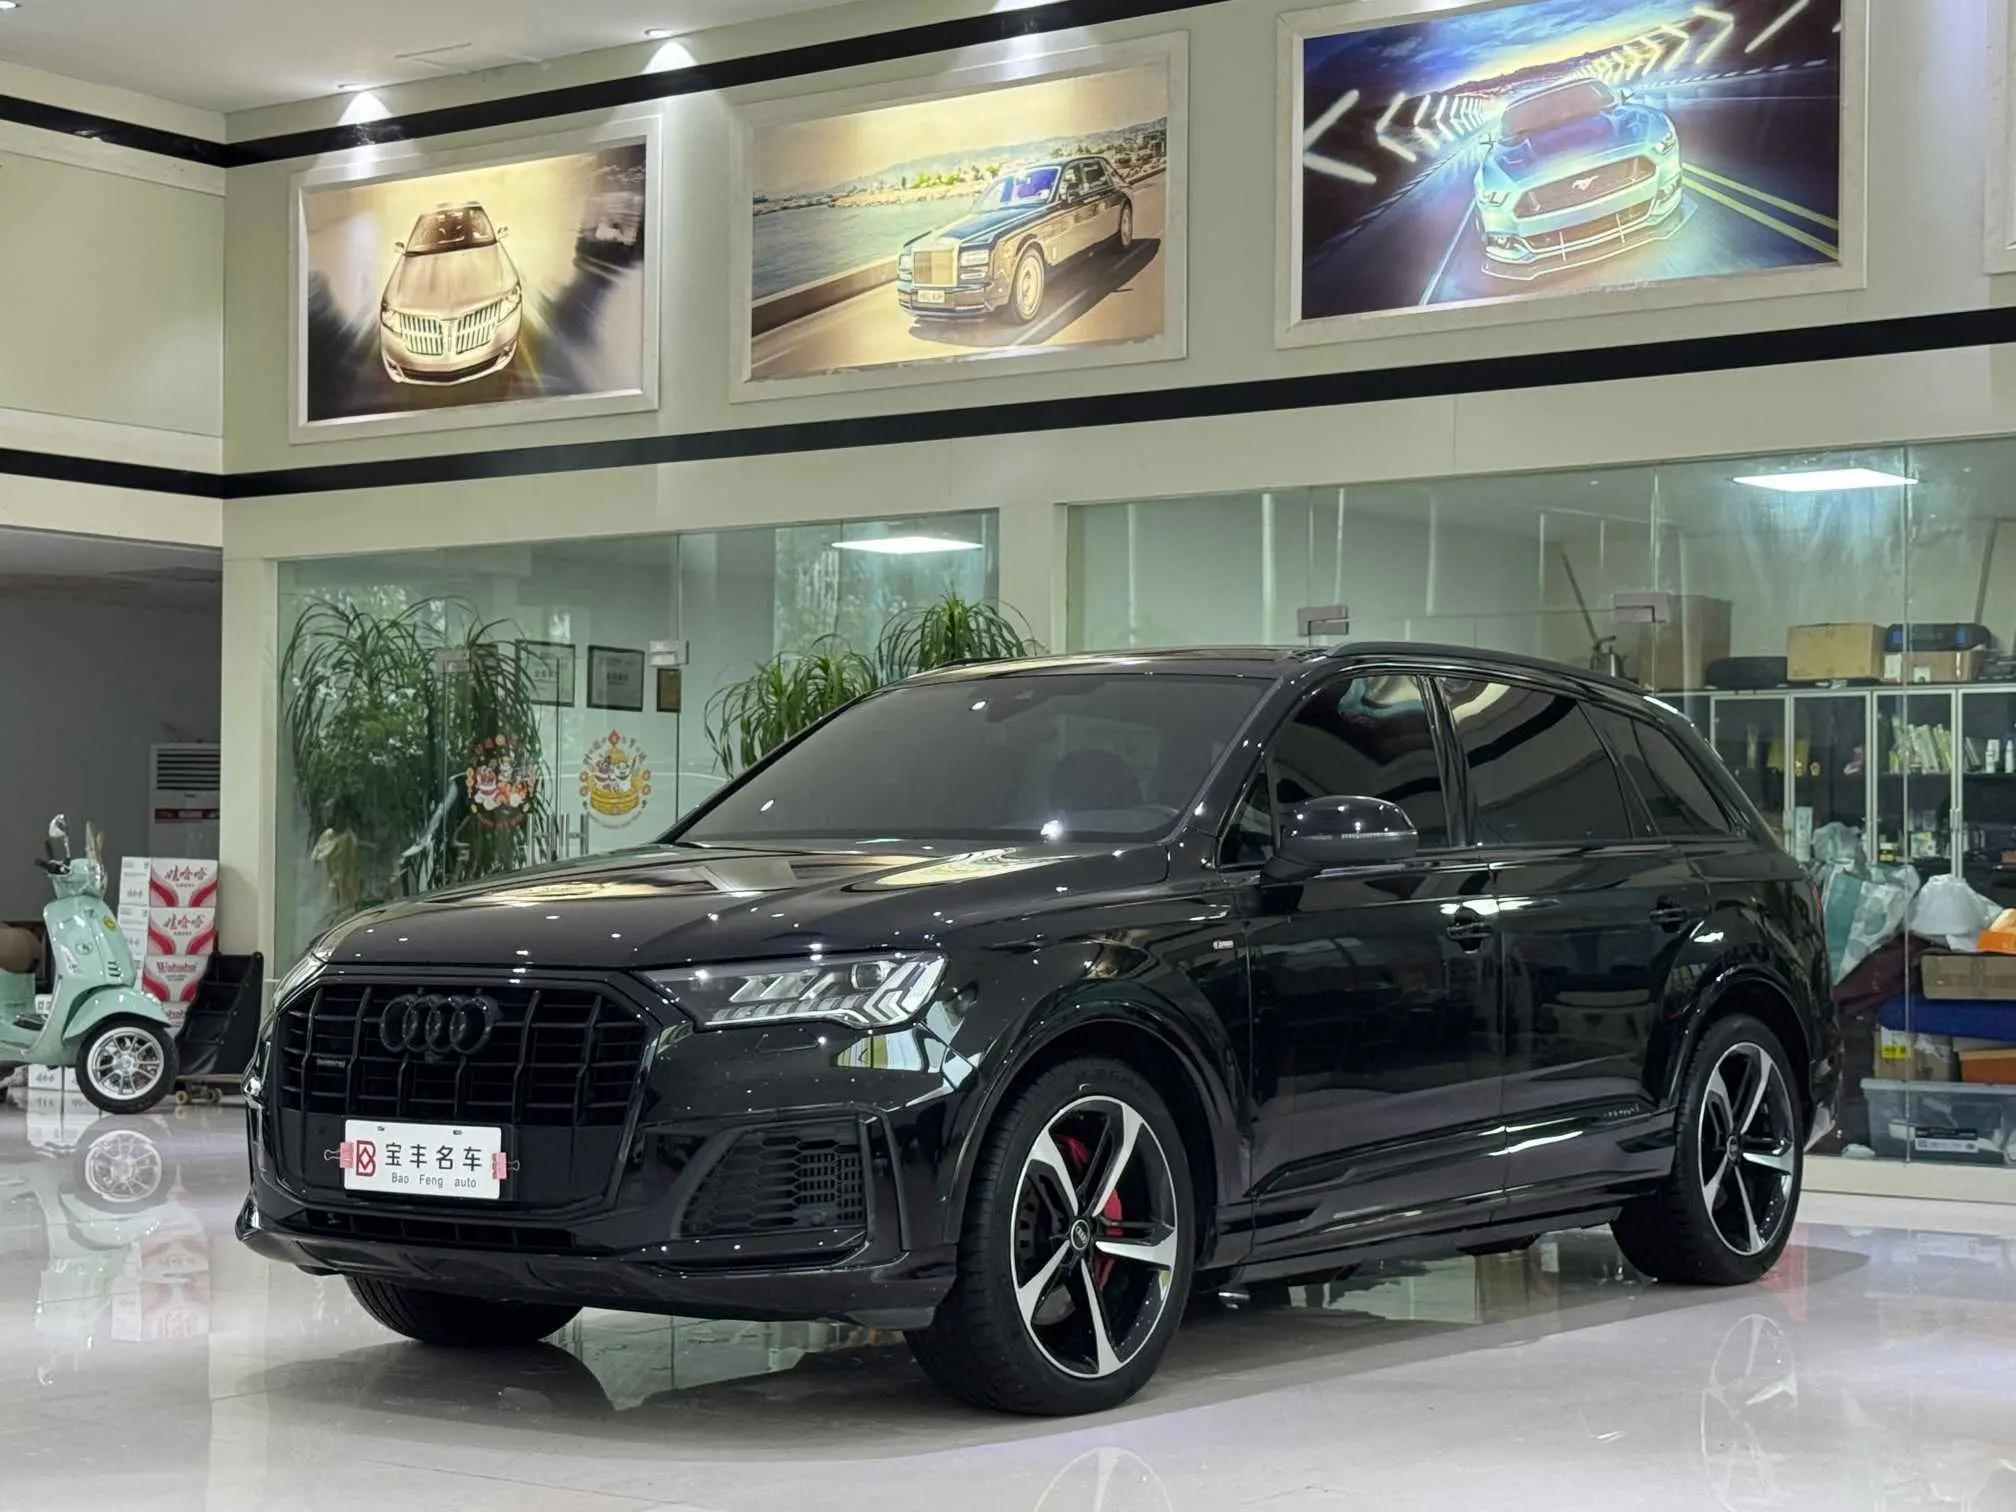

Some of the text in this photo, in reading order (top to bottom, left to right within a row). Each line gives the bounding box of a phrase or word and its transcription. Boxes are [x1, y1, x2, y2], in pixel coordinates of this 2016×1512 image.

[385, 1142, 483, 1172] 宝丰名车
[391, 1172, 477, 1189] Bao Feng auto
